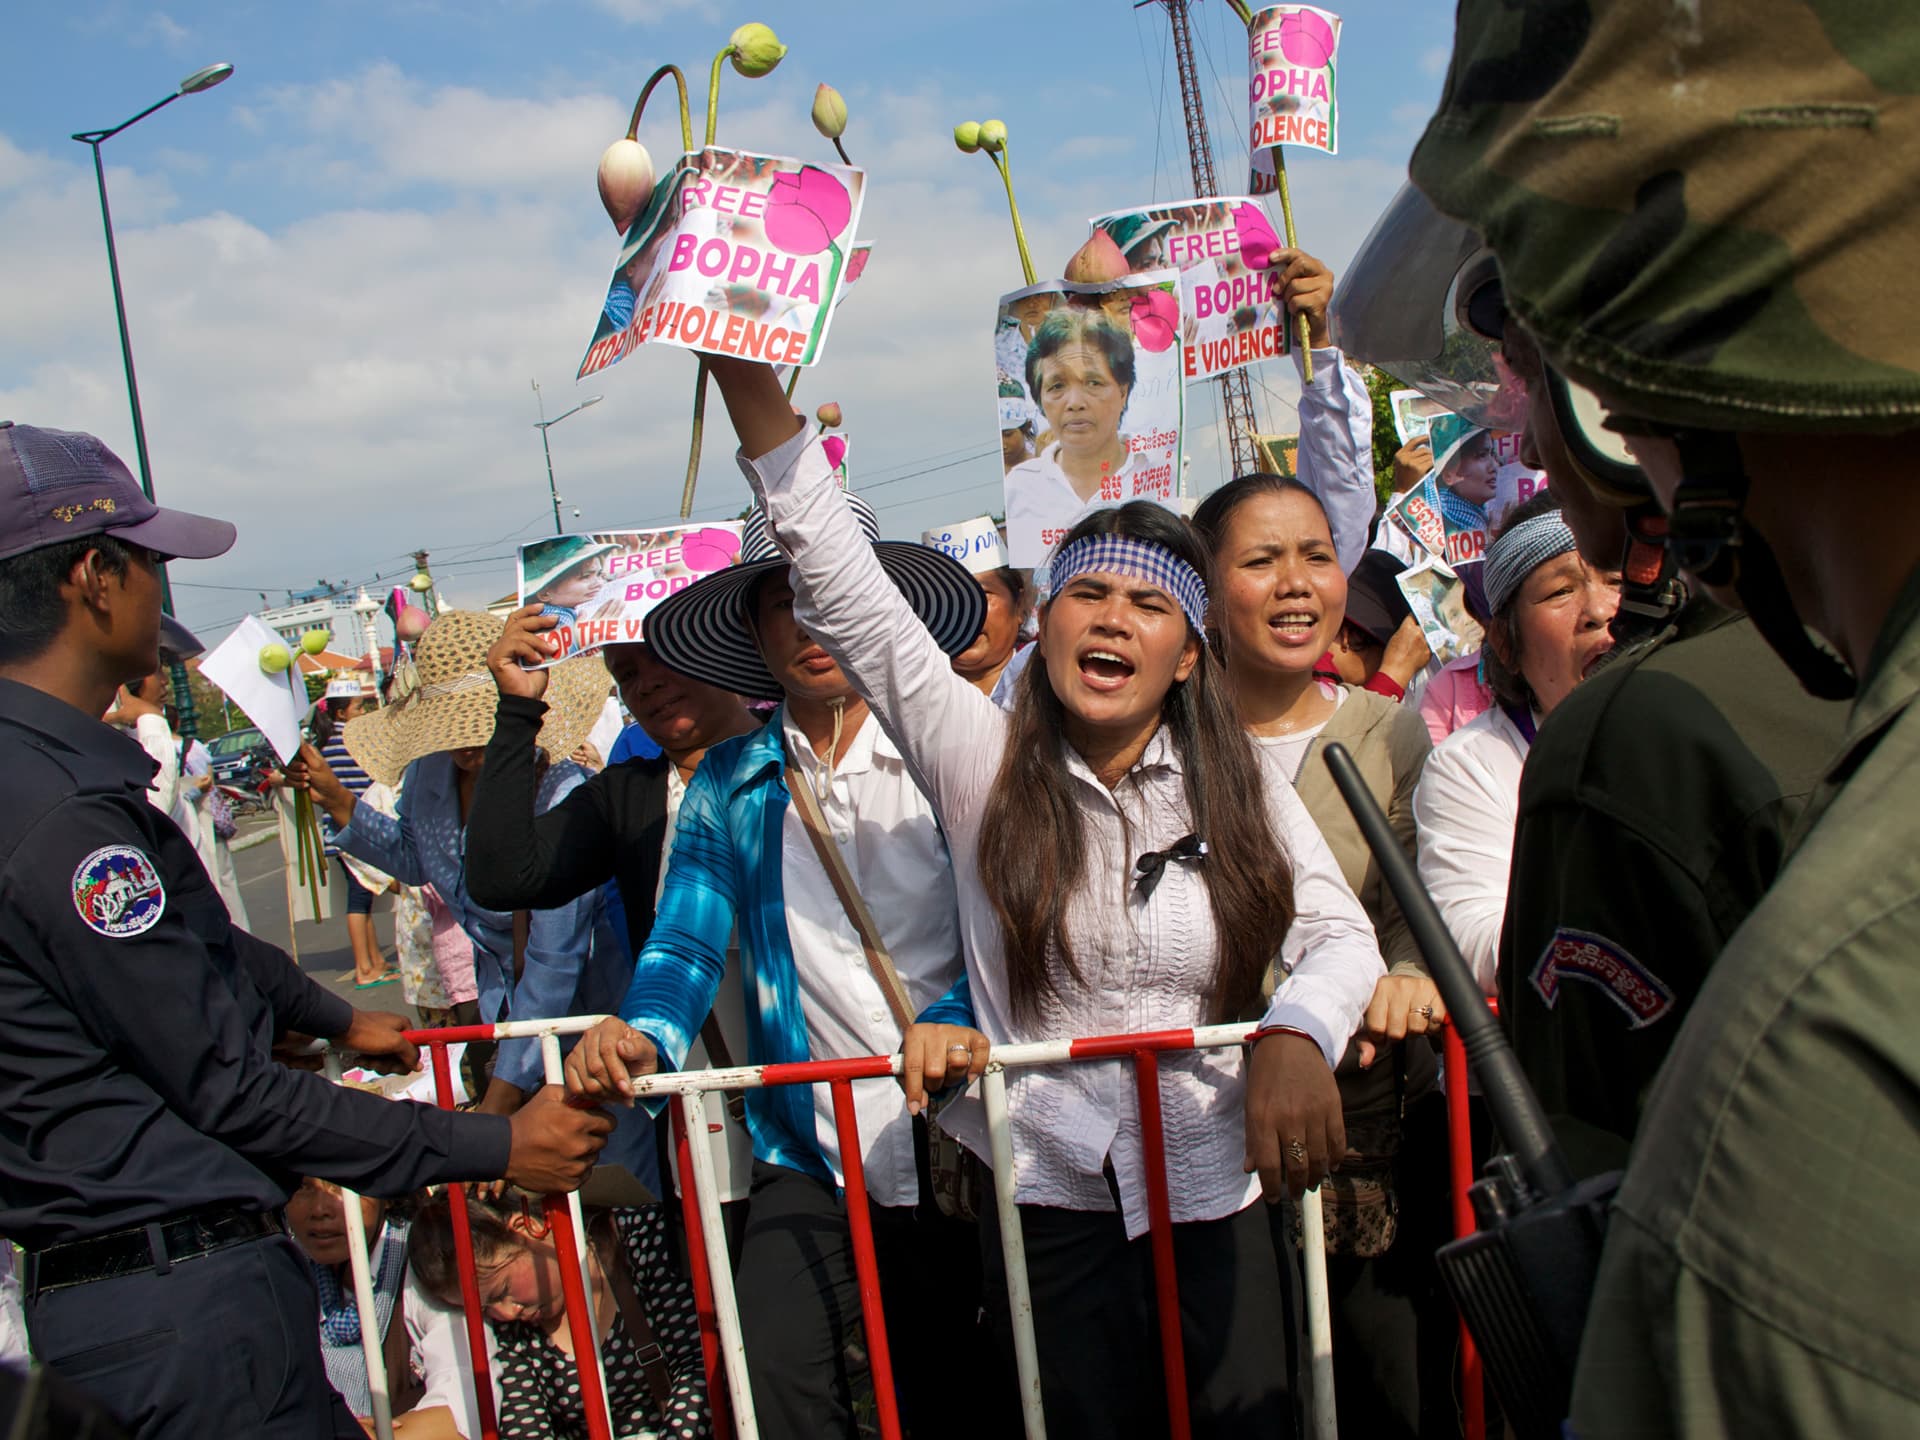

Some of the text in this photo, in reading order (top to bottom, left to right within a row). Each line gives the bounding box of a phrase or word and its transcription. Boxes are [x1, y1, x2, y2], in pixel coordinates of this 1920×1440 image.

[1251, 30, 1280, 58] EE
[1252, 69, 1329, 103] OPHA
[1250, 115, 1328, 149] OLENCE
[682, 178, 767, 219] FREE
[1169, 229, 1239, 265] FREE
[668, 233, 820, 305] BOPHA
[653, 301, 807, 365] VIOLENCE
[1201, 324, 1284, 373] VIOLENCE
[609, 546, 681, 574] FREE
[624, 574, 712, 602] BOP
[577, 620, 618, 649] THE
